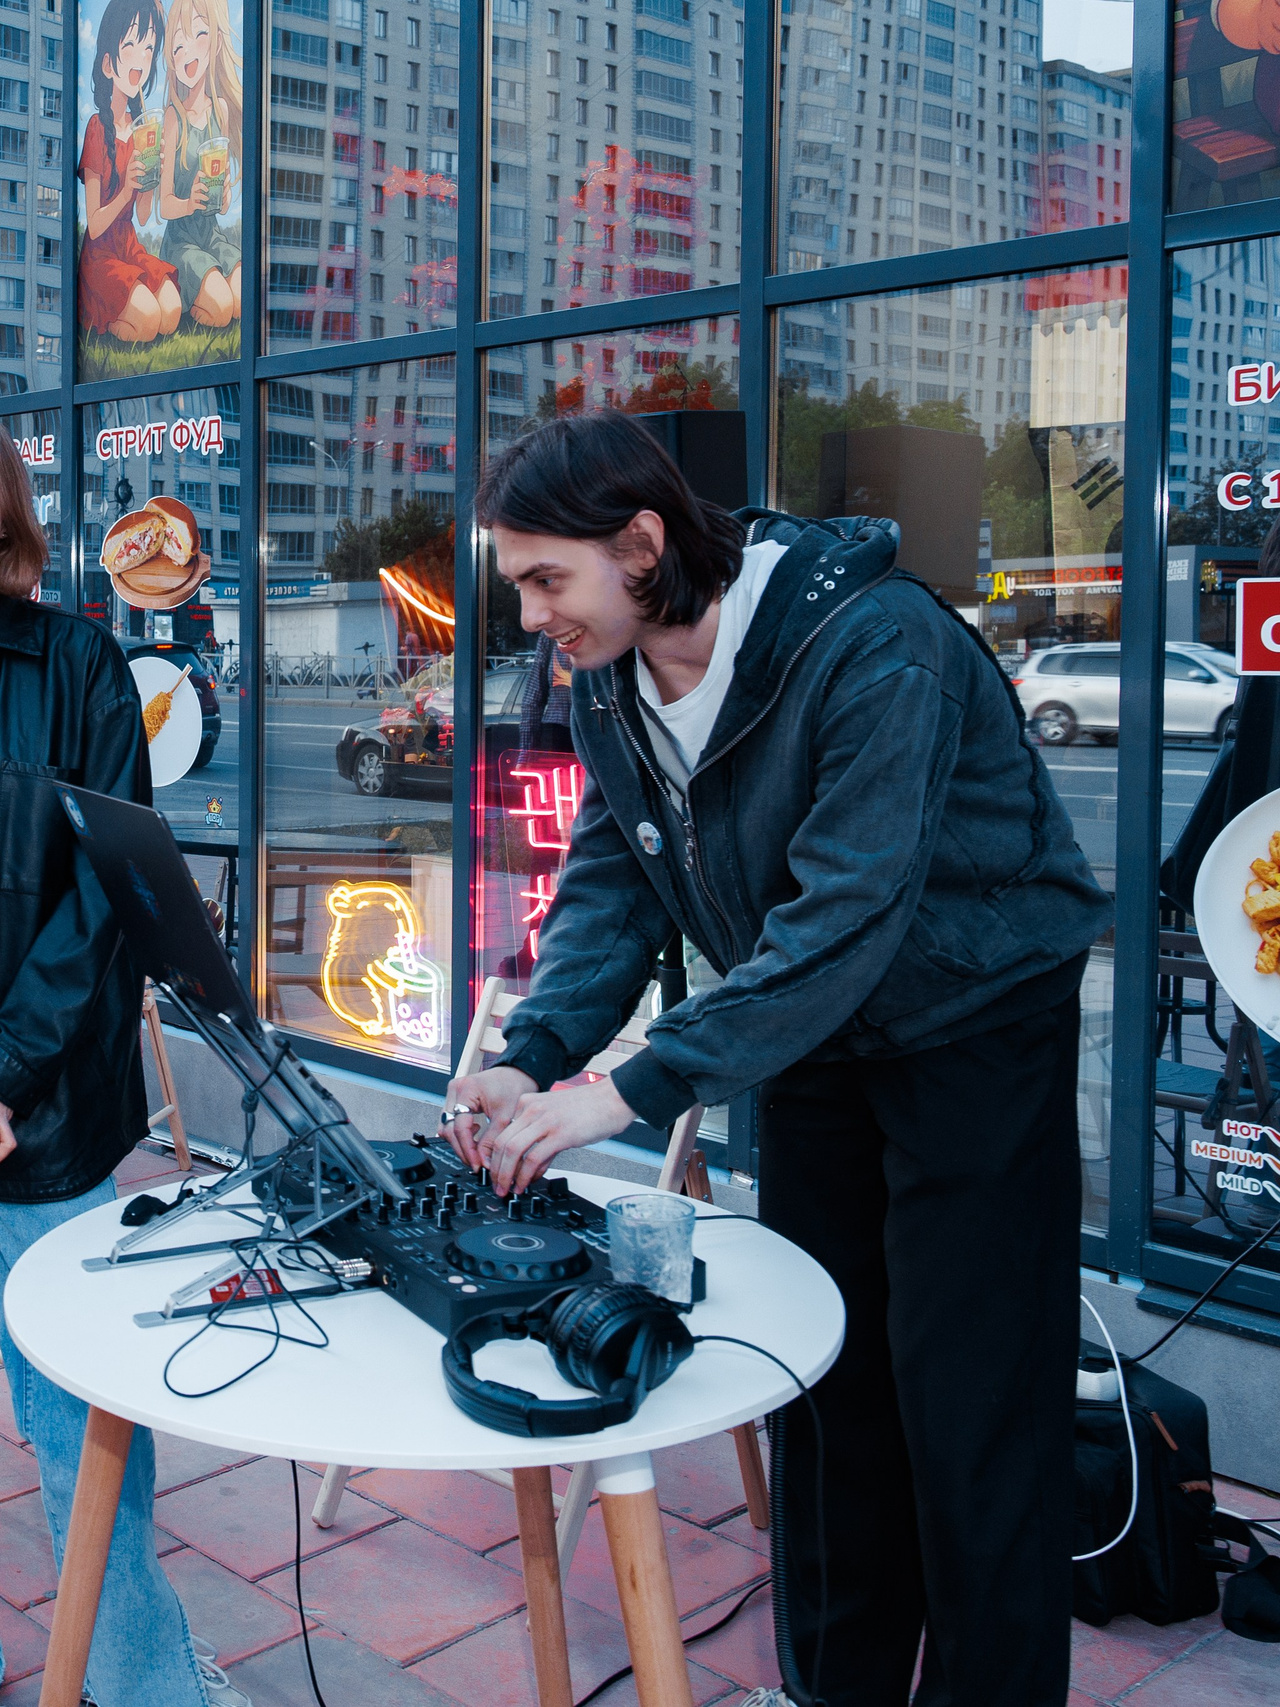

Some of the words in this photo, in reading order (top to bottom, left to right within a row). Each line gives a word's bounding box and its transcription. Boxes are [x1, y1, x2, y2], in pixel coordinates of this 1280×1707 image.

[98, 424, 167, 458] СТРИТ
[173, 418, 223, 453] ФУД
[1227, 1122, 1262, 1139] HOT
[1195, 1142, 1262, 1167] MEDIUM
[1221, 1174, 1262, 1193] MILD
